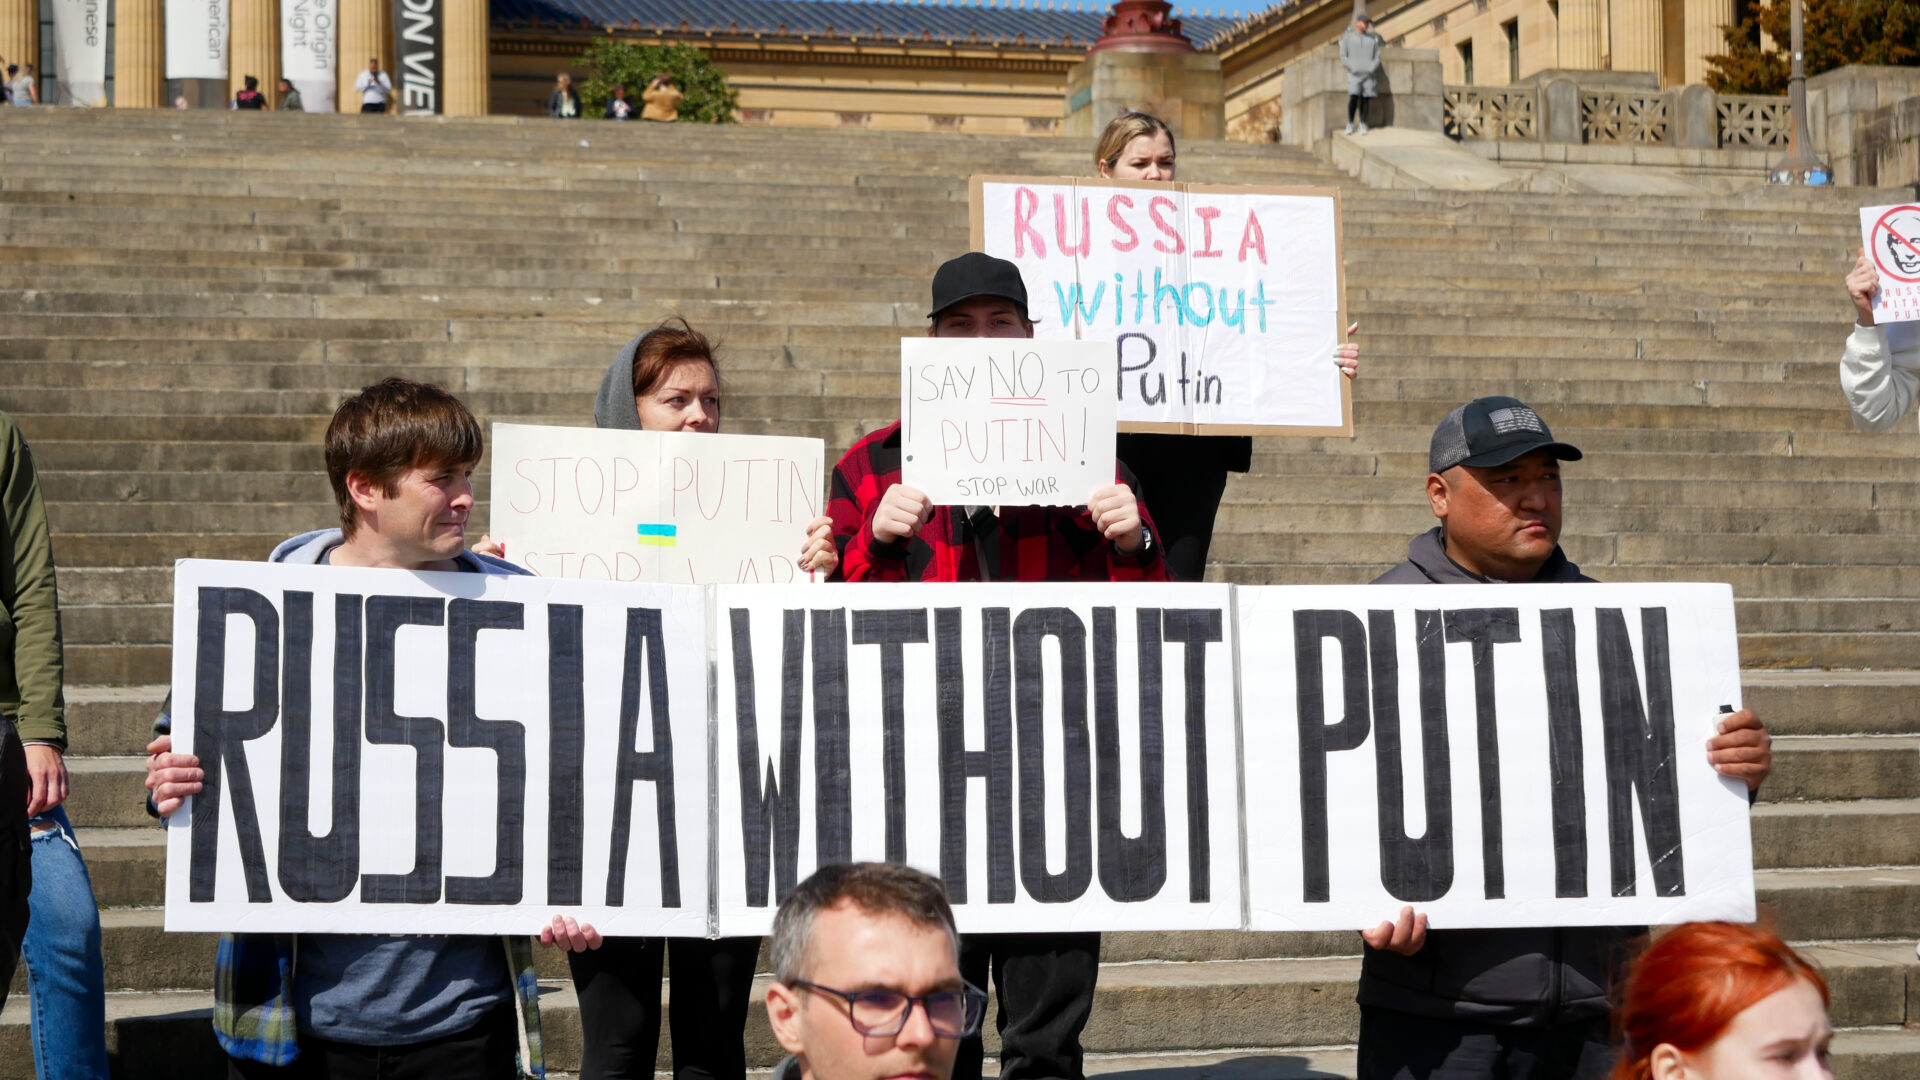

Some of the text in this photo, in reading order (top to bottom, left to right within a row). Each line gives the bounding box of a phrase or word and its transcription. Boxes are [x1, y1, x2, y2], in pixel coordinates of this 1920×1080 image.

[85, 0, 98, 47] nese
[311, 13, 332, 70] Origin
[1014, 186, 1268, 265] RUSSIA
[1054, 266, 1277, 335] without
[917, 350, 1100, 402] SAY NO TO
[1115, 331, 1222, 407] Putin
[509, 456, 819, 525] STOP PUTIN
[956, 476, 1060, 497] STOP WAR
[189, 586, 1686, 909] RUSSIA WITHOUT PUTIN
